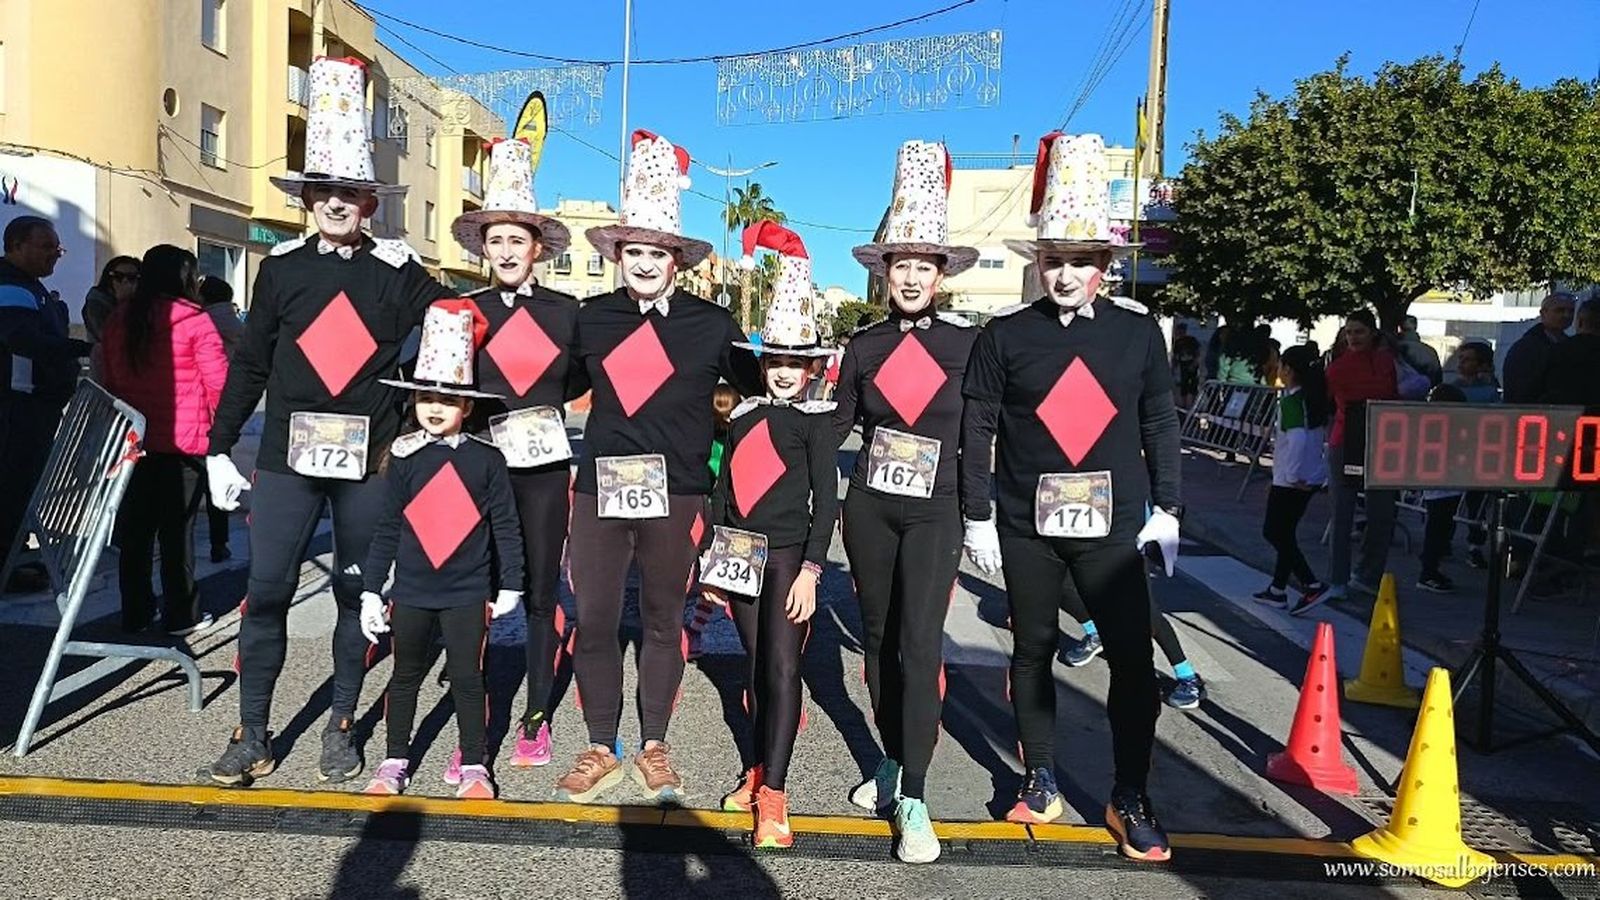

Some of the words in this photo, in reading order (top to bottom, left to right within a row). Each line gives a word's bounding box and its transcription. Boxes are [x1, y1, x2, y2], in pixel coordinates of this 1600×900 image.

[308, 447, 349, 468] 172
[881, 463, 918, 487] 167
[614, 488, 652, 510] 165
[1055, 507, 1093, 528] 171
[716, 559, 751, 584] 334
